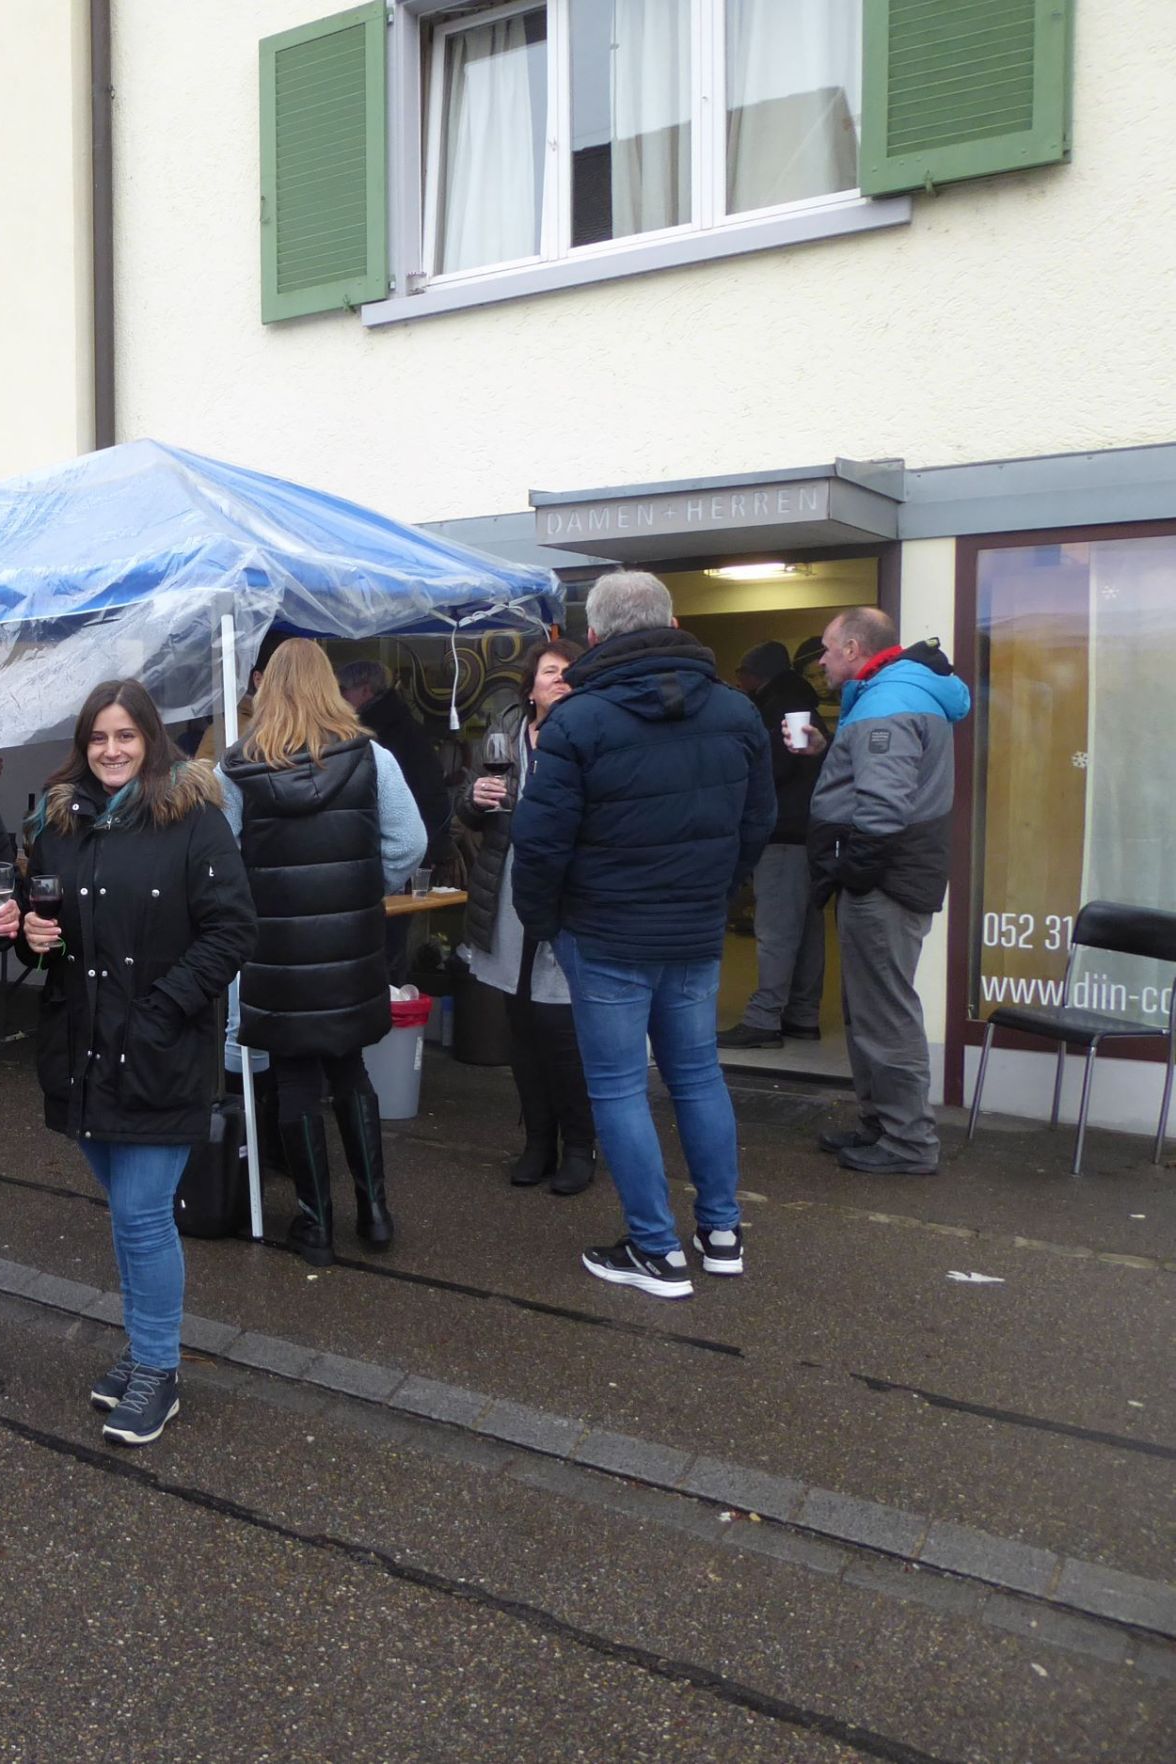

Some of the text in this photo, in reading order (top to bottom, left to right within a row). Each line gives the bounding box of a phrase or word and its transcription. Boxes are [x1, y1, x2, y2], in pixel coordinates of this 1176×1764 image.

[546, 505, 653, 534] DAMEN
[686, 488, 817, 522] HERREN
[983, 912, 1074, 951] 052 31
[981, 971, 1173, 1014] www.diin-co
